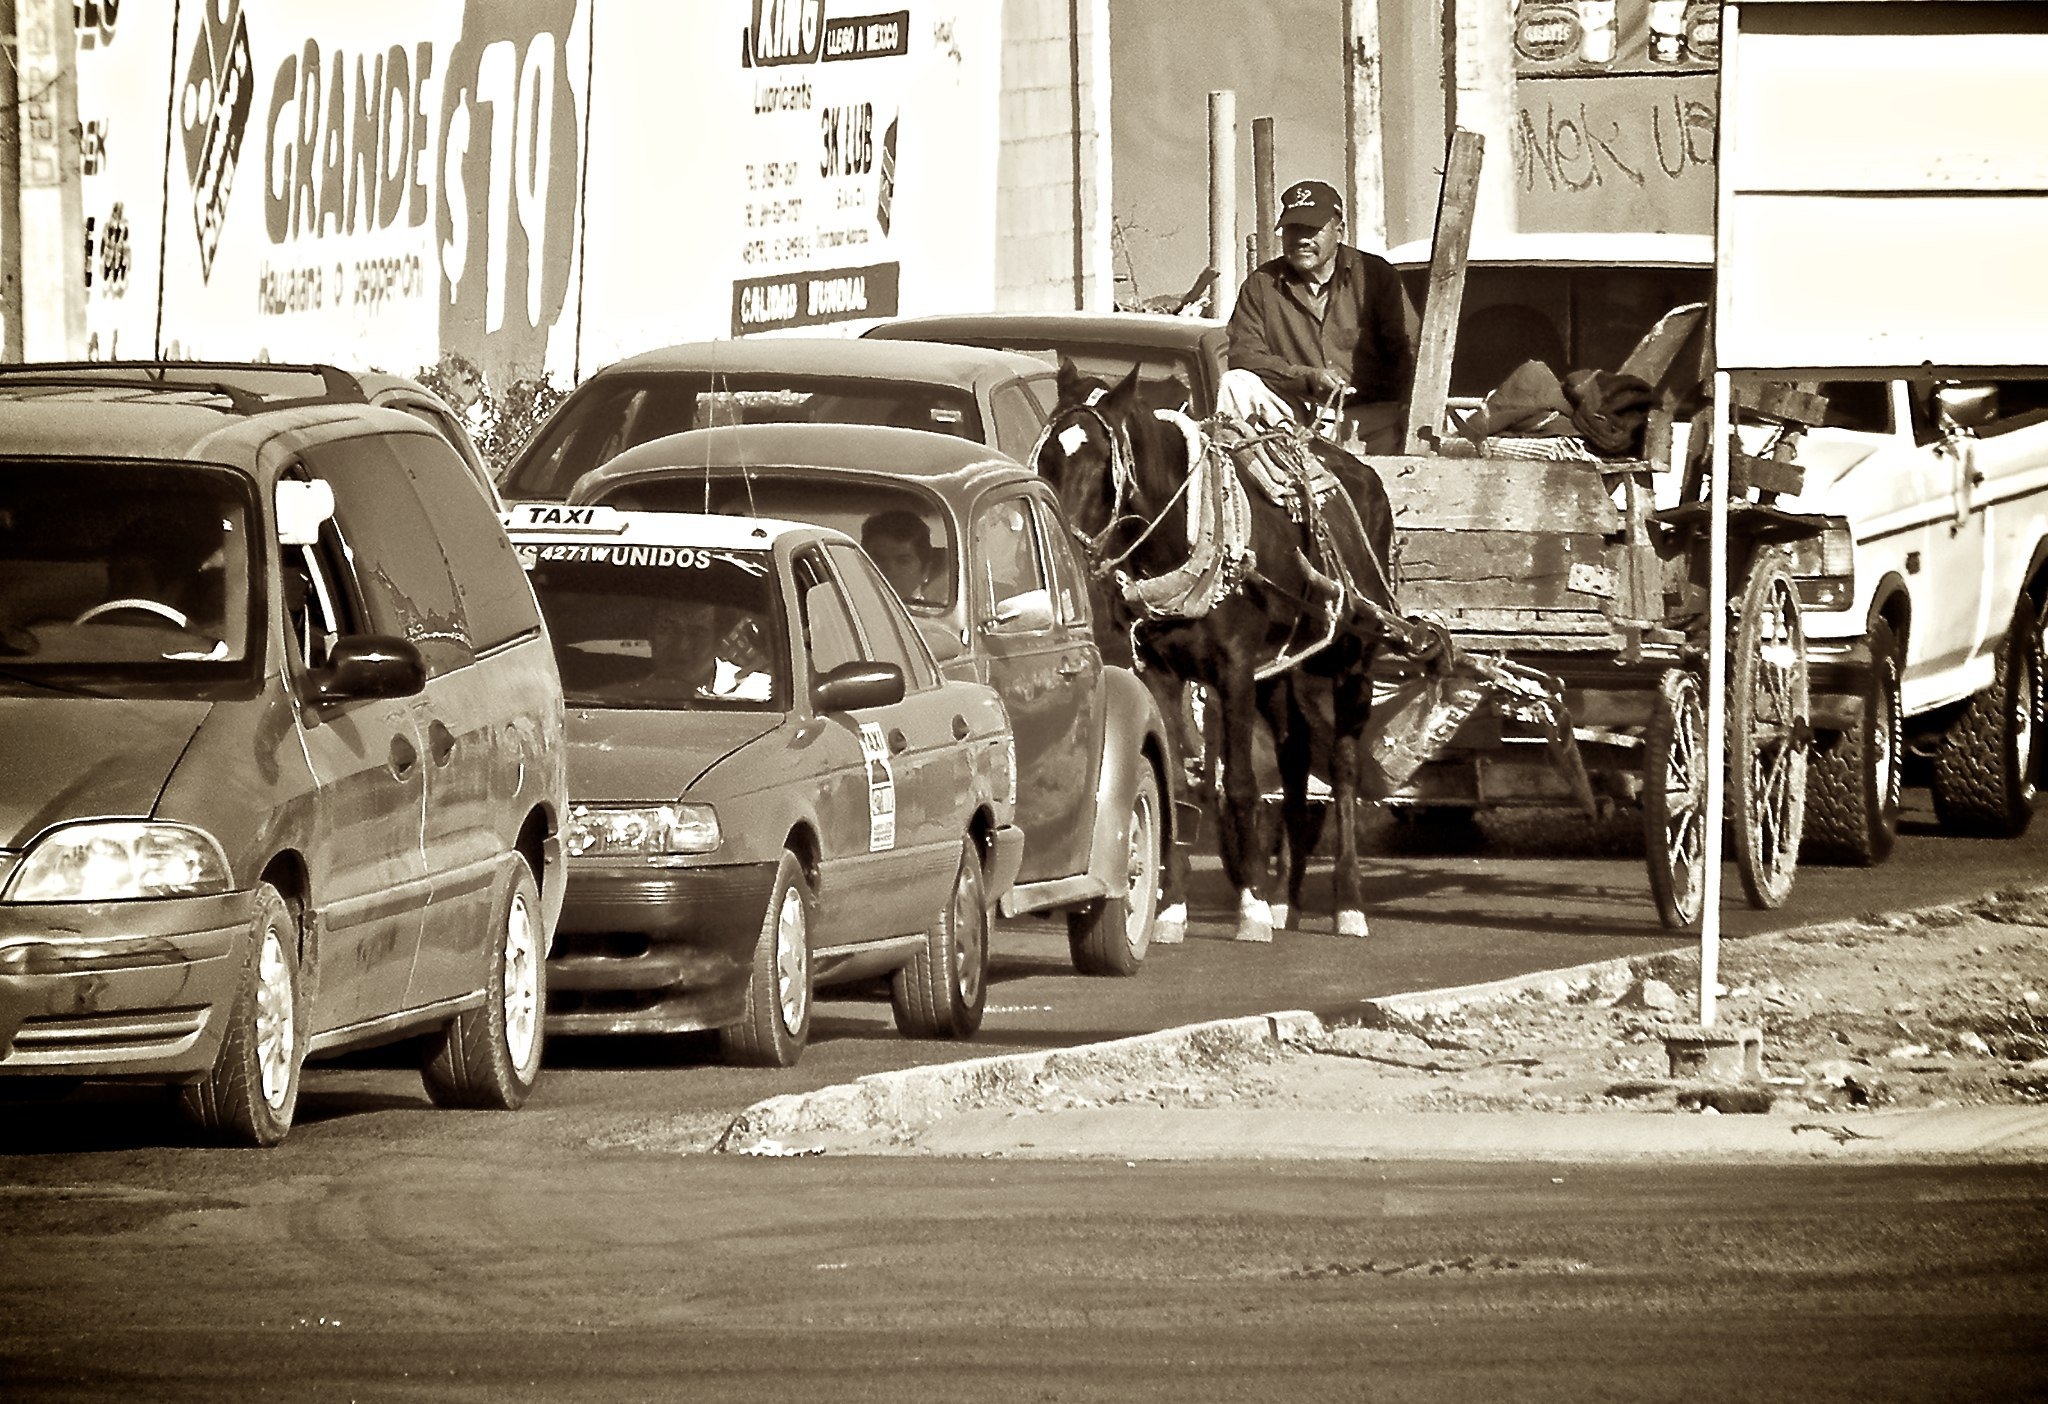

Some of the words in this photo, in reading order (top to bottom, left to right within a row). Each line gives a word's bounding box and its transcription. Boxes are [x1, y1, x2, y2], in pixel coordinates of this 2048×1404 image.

[857, 26, 864, 52] A
[264, 37, 432, 244] GRANDE
[741, 283, 797, 323] CALIDAD
[529, 508, 594, 524] TAXI
[612, 547, 711, 569] UNIDOS
